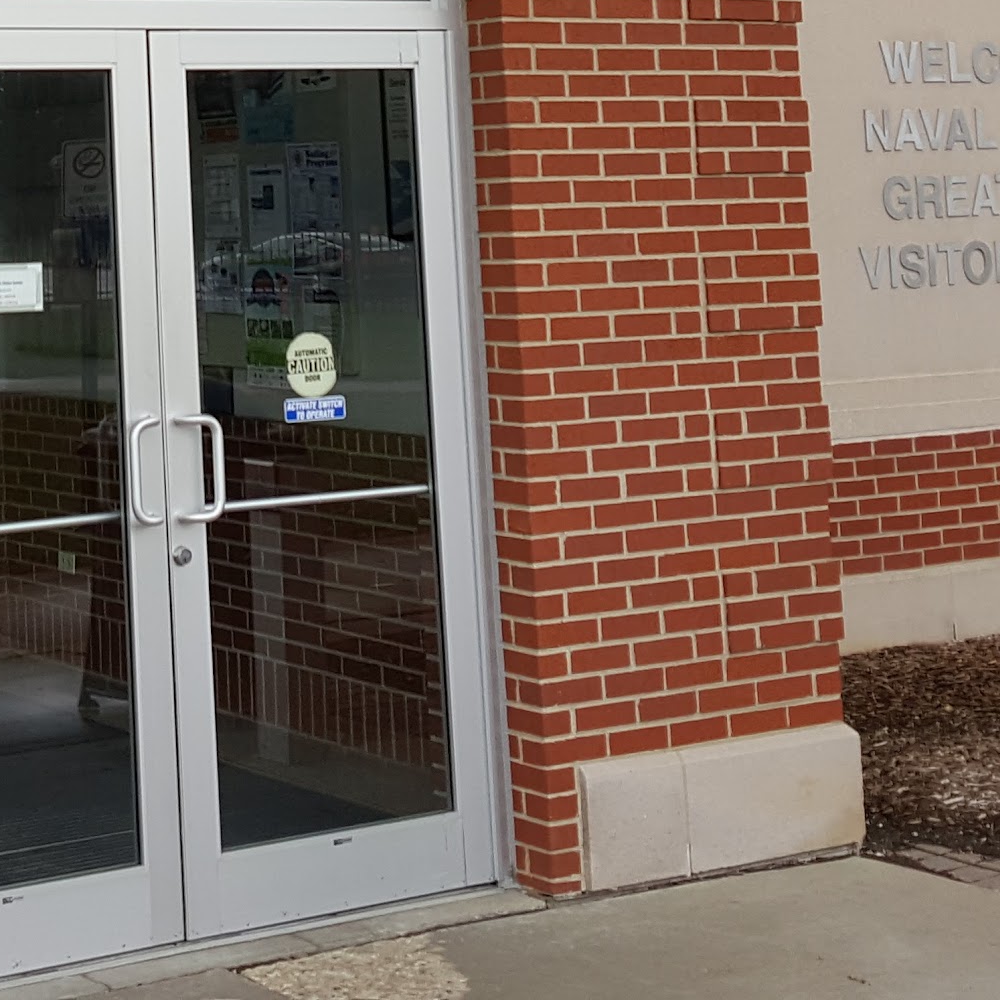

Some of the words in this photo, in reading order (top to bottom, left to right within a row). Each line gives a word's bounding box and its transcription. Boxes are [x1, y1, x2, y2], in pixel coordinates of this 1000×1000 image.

[879, 40, 1000, 84] WELC
[863, 108, 998, 152] NAVAL
[882, 173, 1000, 221] GREA
[858, 240, 1000, 290] VISITO
[295, 348, 327, 357] AUTOMATIC
[287, 357, 335, 375] CAUTION
[305, 374, 320, 382] DOOR
[288, 402, 317, 411] ACTIVATE
[319, 400, 343, 409] SWITCH
[298, 411, 305, 420] TO
[306, 409, 335, 419] OPERATE
